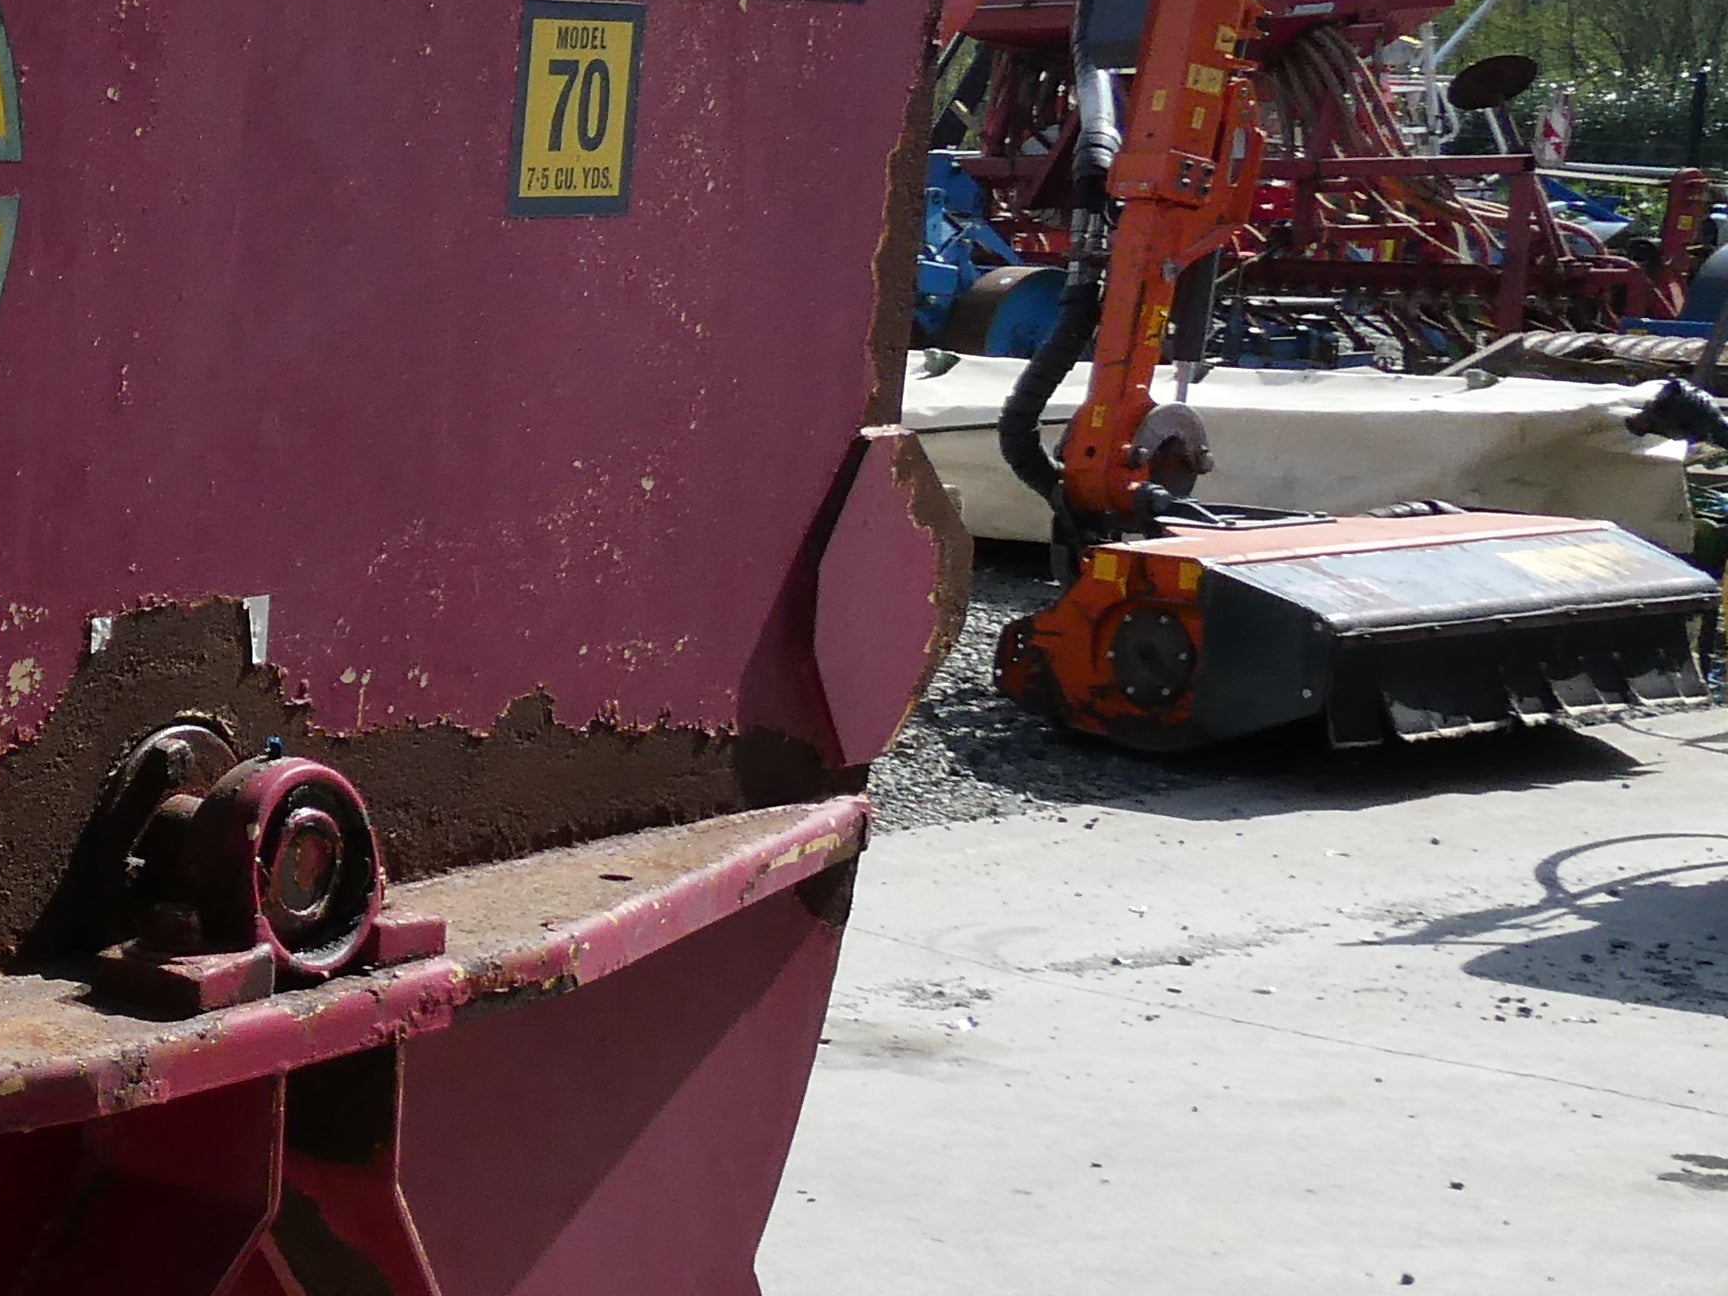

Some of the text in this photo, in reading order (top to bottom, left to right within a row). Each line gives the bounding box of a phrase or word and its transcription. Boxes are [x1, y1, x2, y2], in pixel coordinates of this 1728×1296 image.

[556, 25, 607, 50] MODEL
[547, 58, 611, 152] 70
[554, 167, 578, 191] CU.
[582, 166, 613, 190] YDS.
